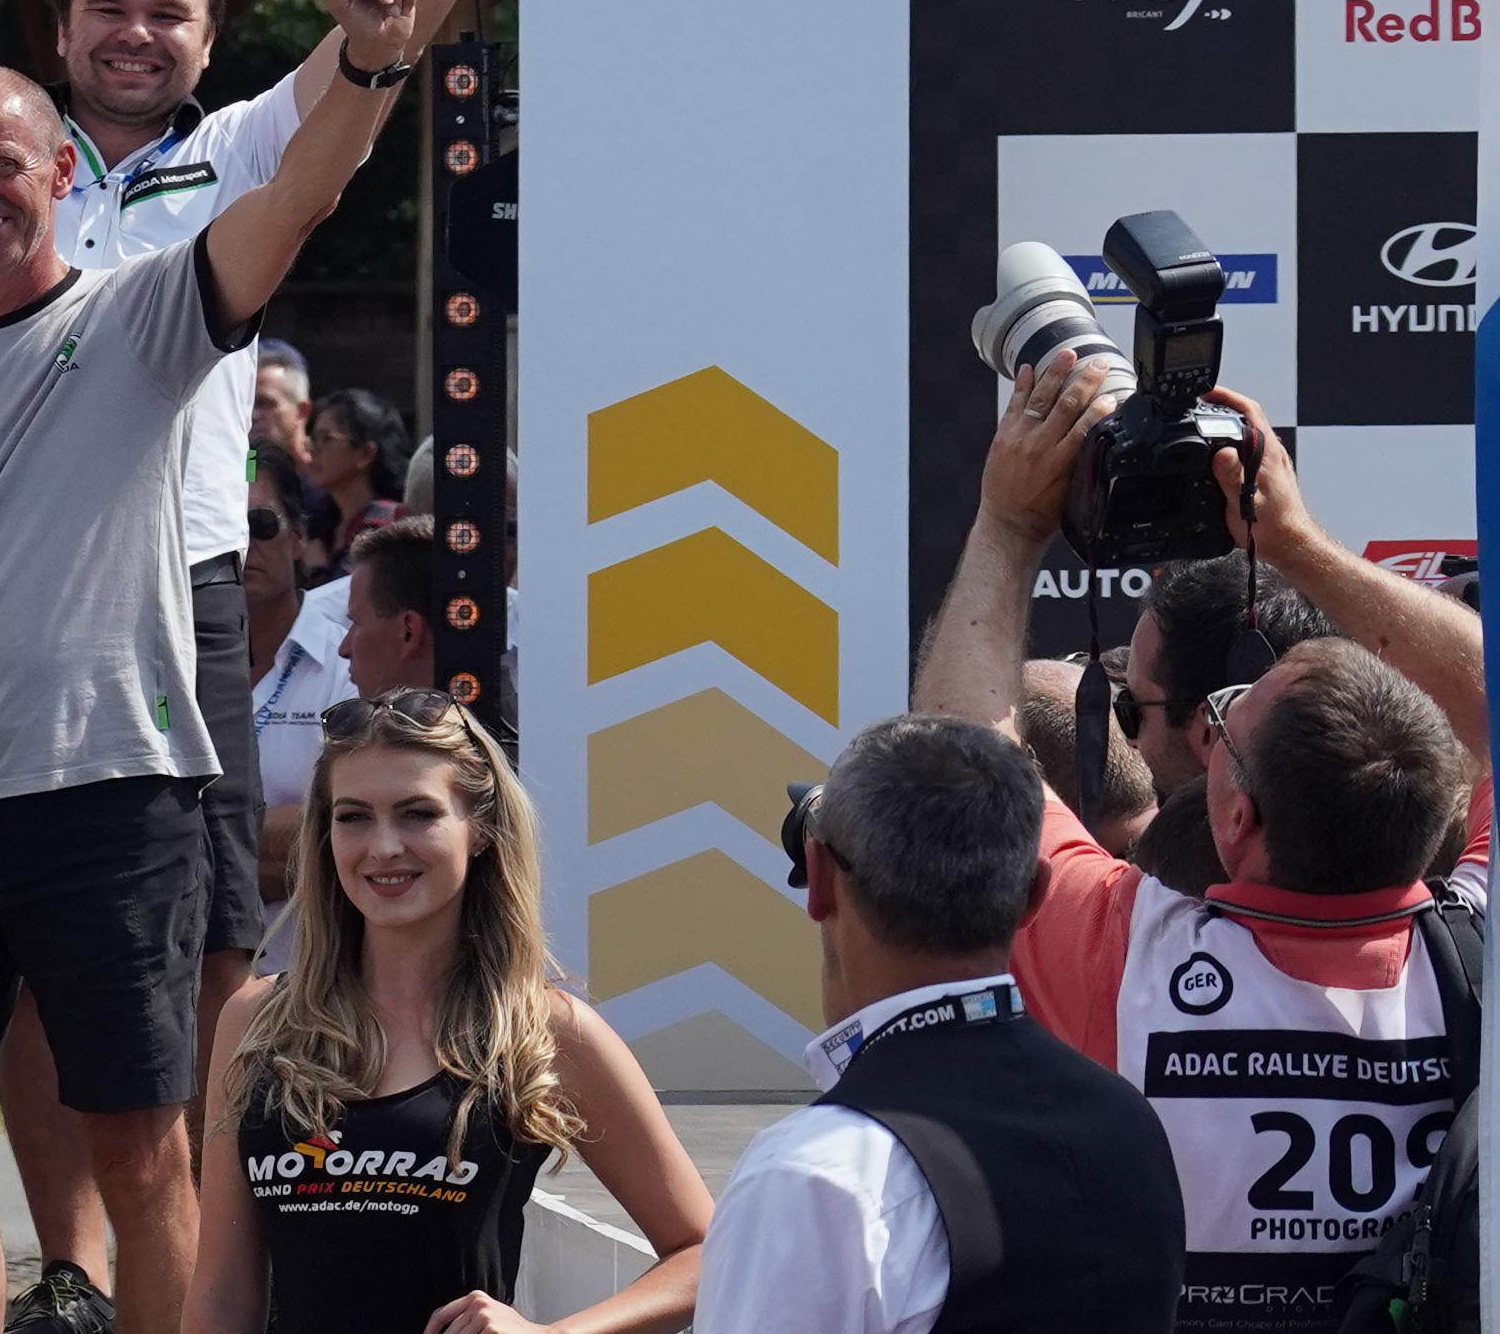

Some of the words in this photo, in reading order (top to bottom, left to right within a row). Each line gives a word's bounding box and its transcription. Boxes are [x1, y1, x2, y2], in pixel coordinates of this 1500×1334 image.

[1031, 568, 1154, 599] AUTO
[1184, 972, 1218, 992] GER
[1164, 1052, 1238, 1077] ADAC
[1247, 1052, 1349, 1079] RALLYE
[253, 1183, 293, 1198] GRAND
[296, 1182, 335, 1196] PRIX
[340, 1180, 468, 1205] DEUTSCHLAND
[278, 1198, 420, 1216] www.adac.de/motogp
